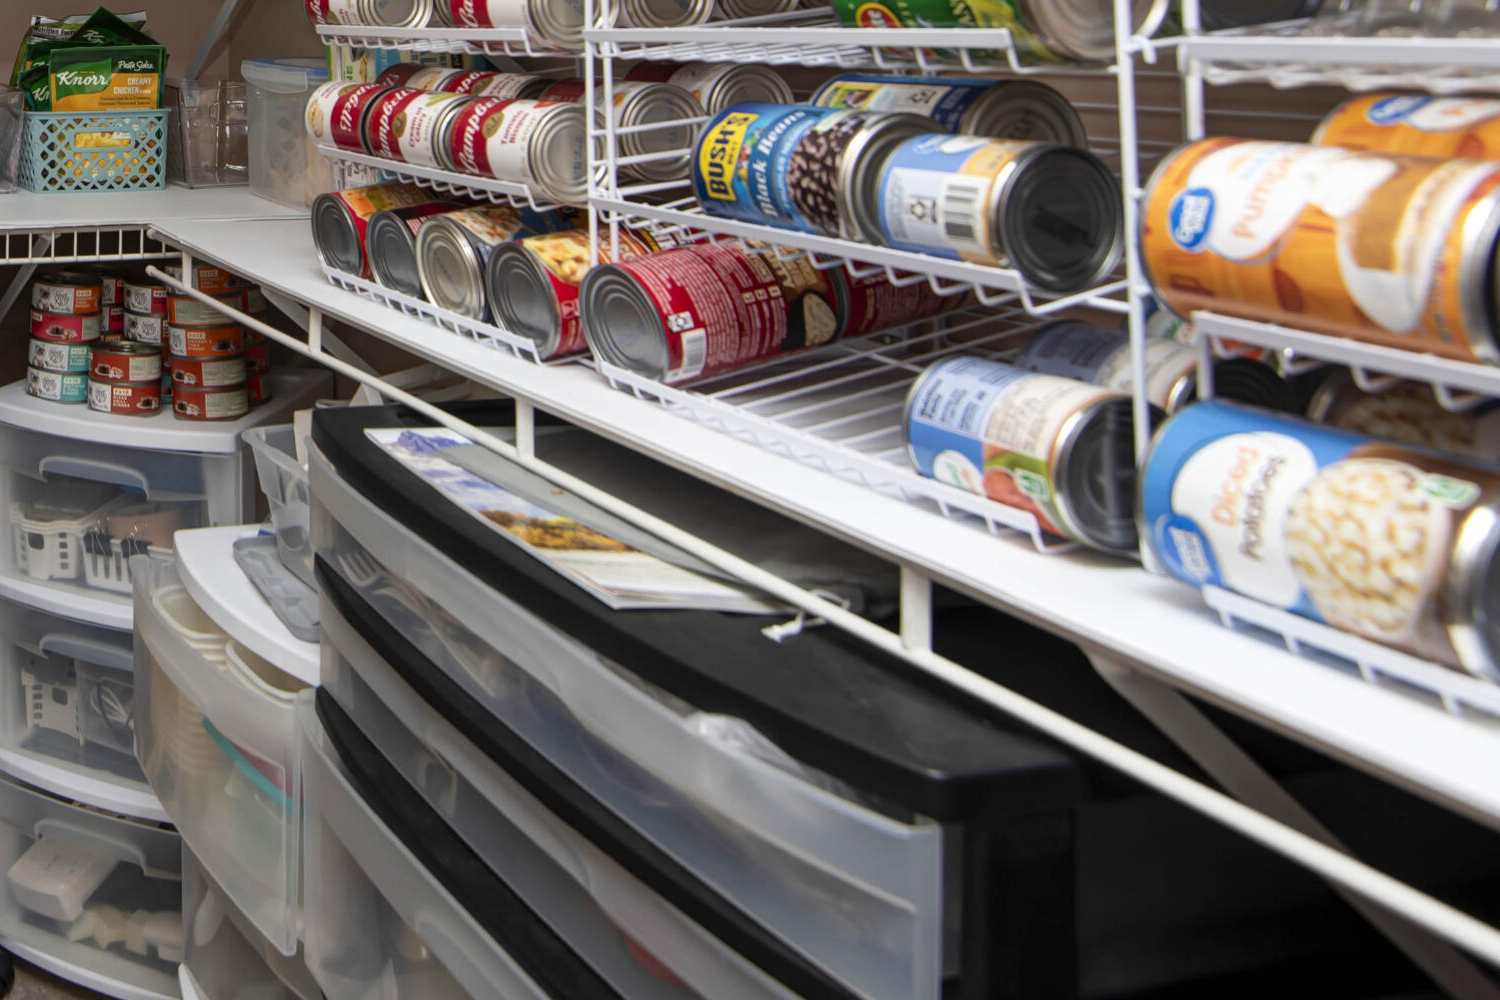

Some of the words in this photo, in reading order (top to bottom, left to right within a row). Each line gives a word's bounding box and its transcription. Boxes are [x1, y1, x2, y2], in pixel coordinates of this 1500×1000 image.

[34, 27, 60, 35] Nutrition
[56, 71, 108, 86] Knorr
[118, 60, 136, 70] Pasta
[114, 86, 140, 94] CHICKEN
[128, 77, 152, 85] CREAMY
[757, 110, 806, 155] Beans
[709, 116, 750, 196] BUSH'S
[752, 158, 779, 218] Black
[1212, 447, 1259, 528] Diced
[1240, 456, 1288, 563] Potatoes
